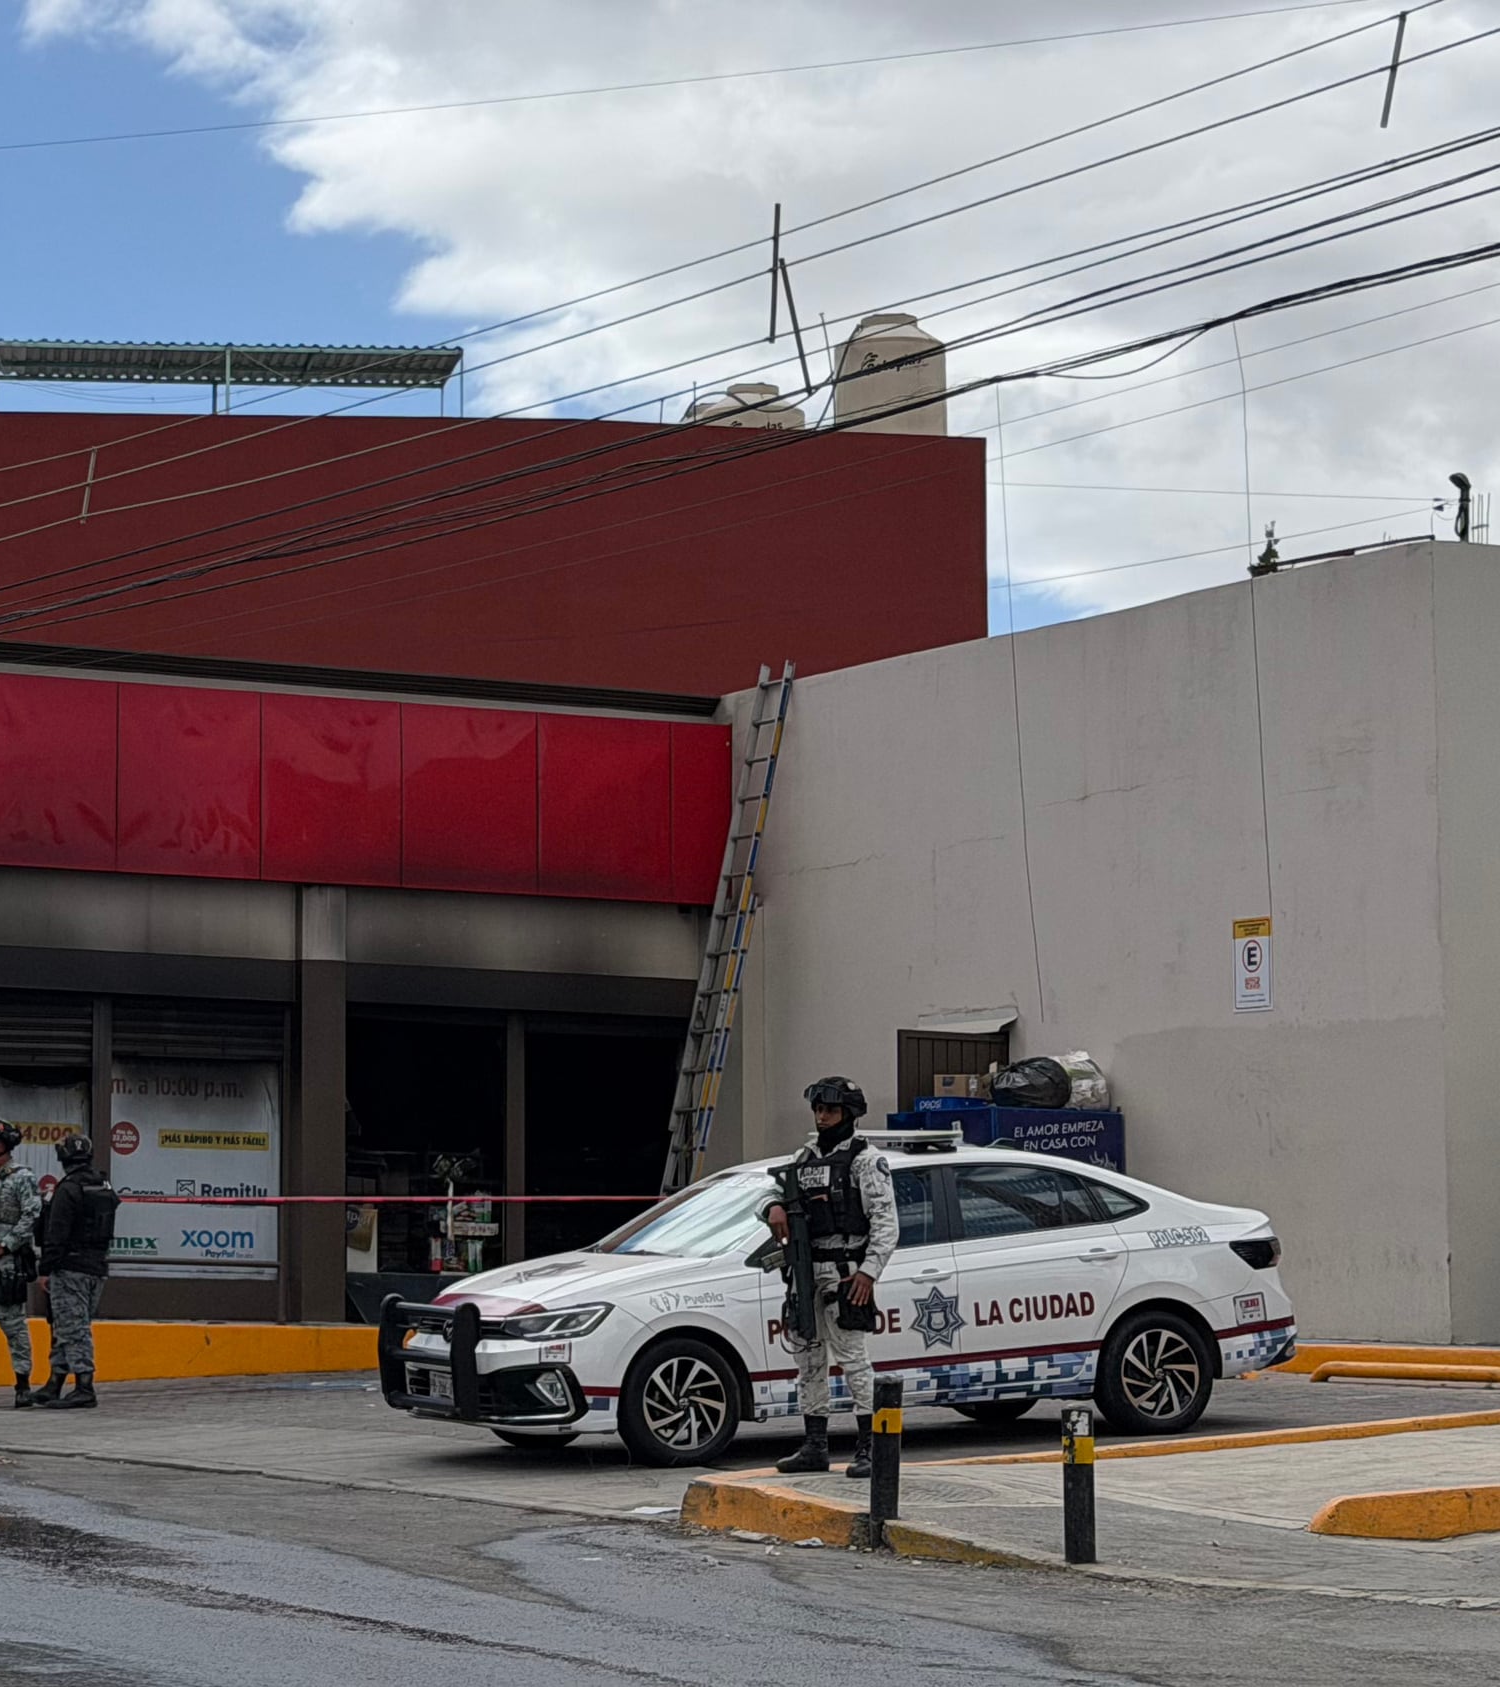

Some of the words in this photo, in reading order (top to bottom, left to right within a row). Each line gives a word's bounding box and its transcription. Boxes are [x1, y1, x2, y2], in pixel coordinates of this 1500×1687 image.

[1247, 946, 1258, 967] E
[138, 1079, 149, 1095] a
[155, 1077, 199, 1097] 10:00
[204, 1079, 244, 1101] p.m.
[919, 1100, 942, 1110] pepsi
[1014, 1127, 1025, 1139] EL
[1025, 1124, 1059, 1137] AMOR
[1061, 1120, 1105, 1134] EMPIEZA
[161, 1134, 181, 1145] ¡MÁS
[184, 1133, 213, 1145] RÁPIDO
[215, 1135, 221, 1145] Y
[223, 1134, 241, 1145] MÁS
[242, 1135, 266, 1146] FÁCIL!
[1023, 1140, 1038, 1152] EN
[1040, 1138, 1068, 1151] CASA
[1069, 1136, 1097, 1148] CON
[109, 1237, 158, 1249] mex
[180, 1229, 254, 1249] xoom
[1148, 1226, 1211, 1248] PDLC-502
[205, 1249, 235, 1259] PayPal
[873, 1308, 902, 1335] DE
[974, 1301, 1004, 1328] LA
[1009, 1291, 1096, 1323] CIUDAD
